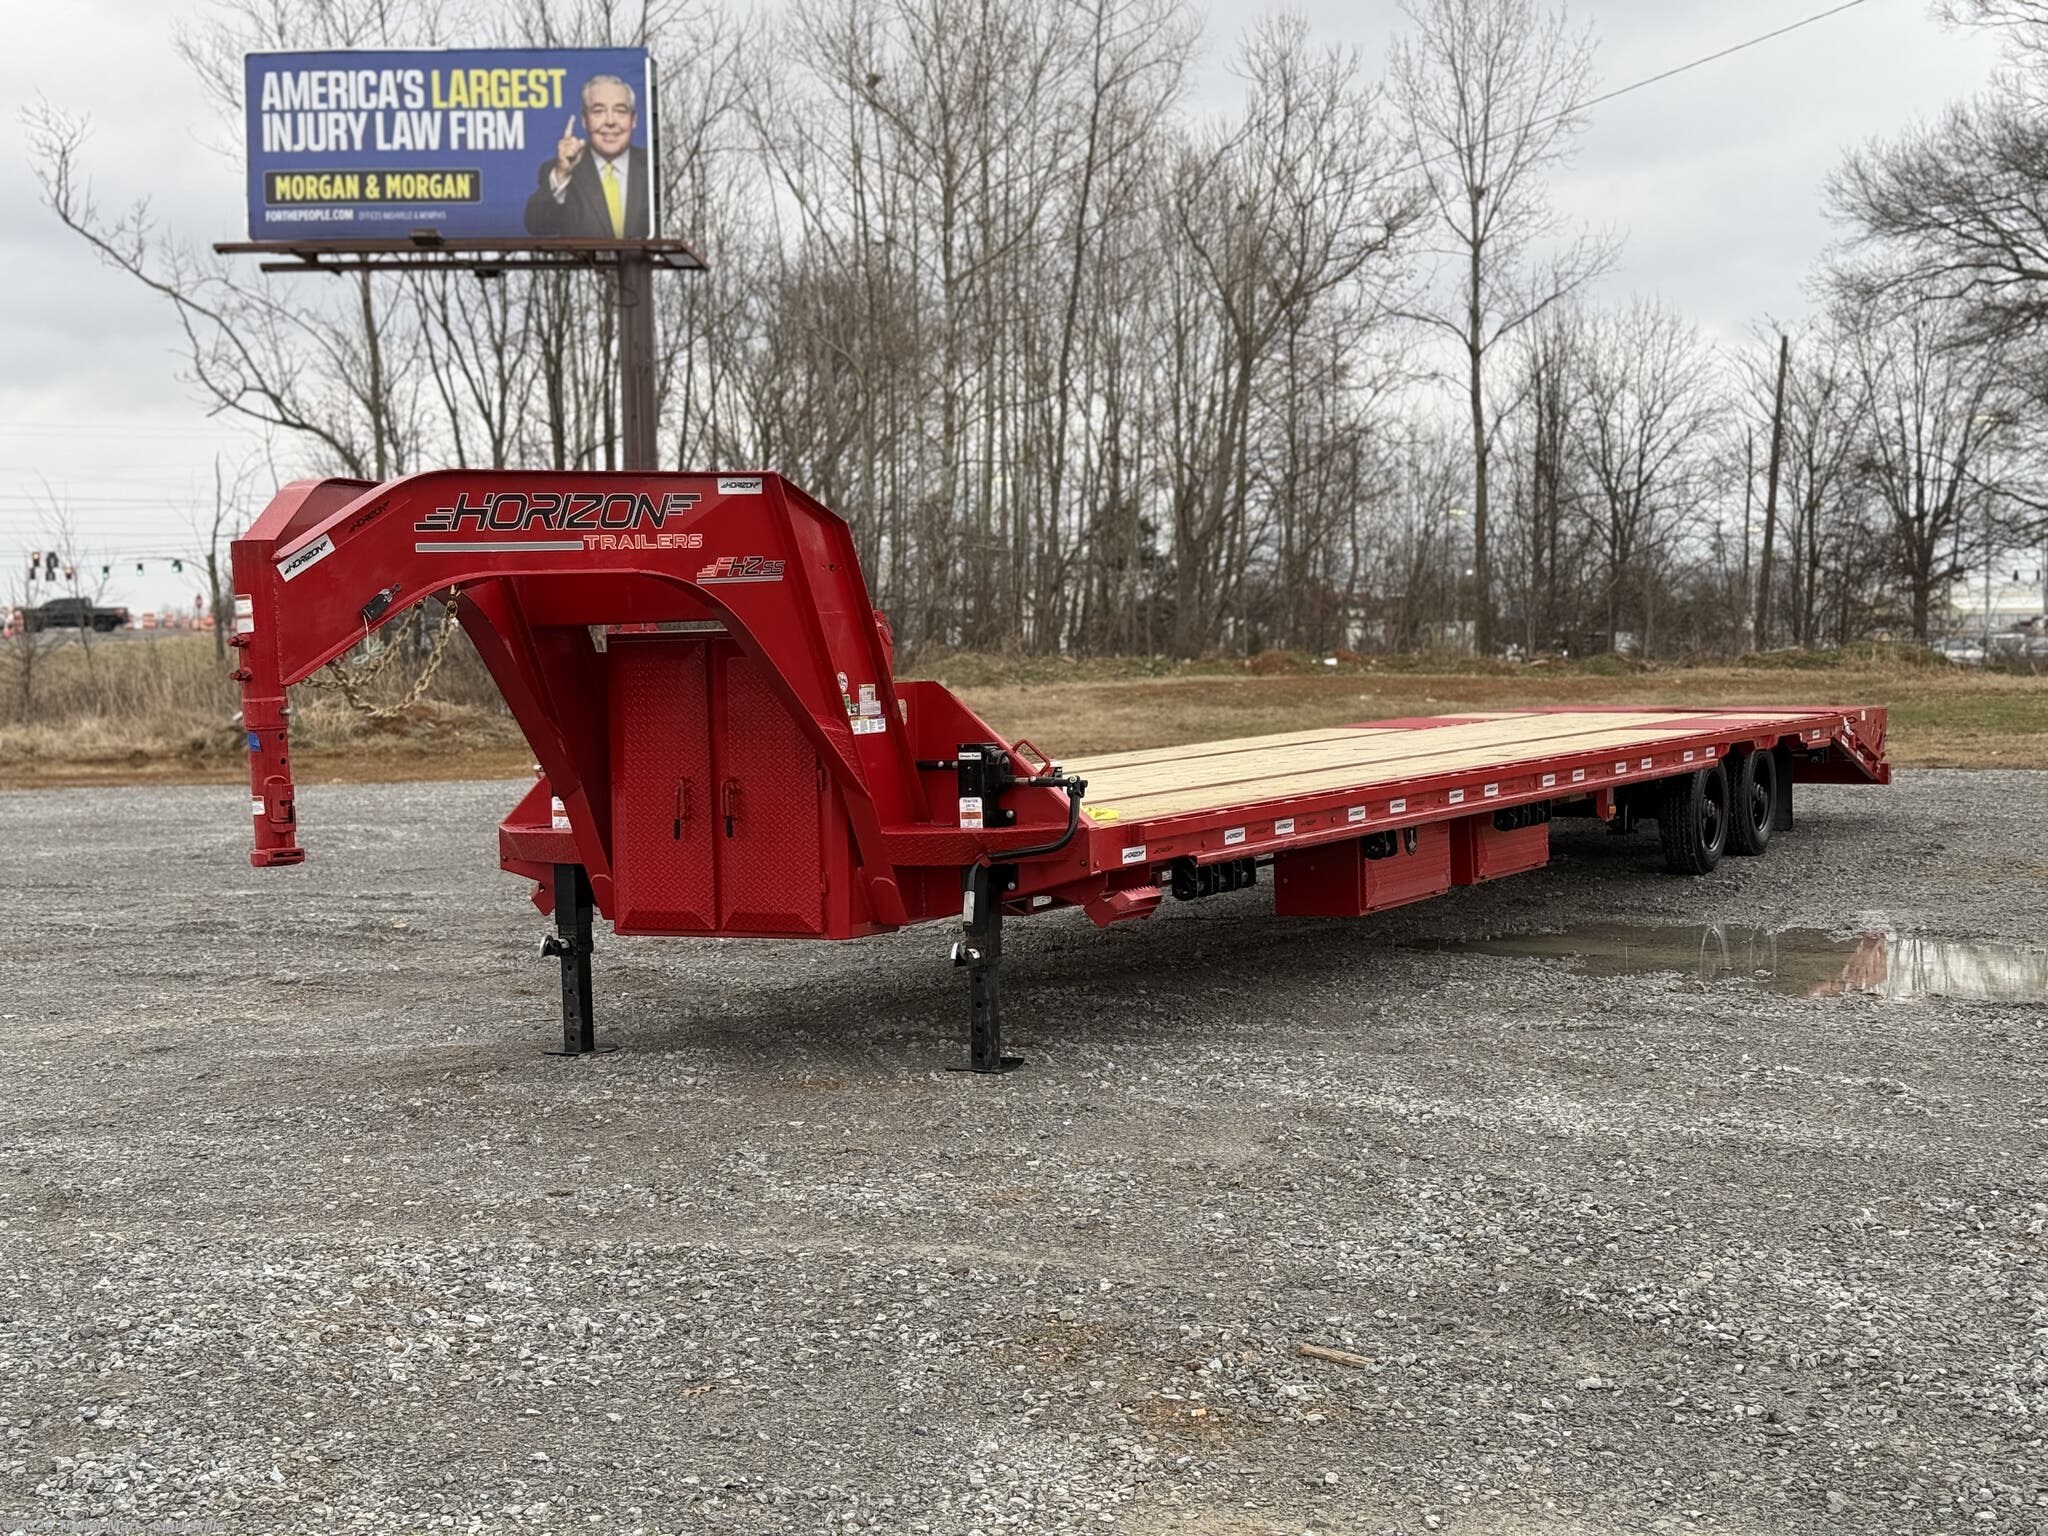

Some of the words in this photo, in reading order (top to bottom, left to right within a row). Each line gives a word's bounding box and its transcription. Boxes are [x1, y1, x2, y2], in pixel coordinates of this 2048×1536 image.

[261, 69, 425, 111] AMERICA'S
[431, 68, 567, 109] LARGEST
[262, 110, 368, 152] INJURY
[375, 110, 442, 151] LAW
[449, 110, 525, 150] FIRM
[275, 173, 360, 200] MORGAN
[365, 173, 380, 199] &
[385, 173, 471, 199] MORGAN
[265, 208, 354, 222] FORTHEPEOPLE.COM
[720, 481, 760, 489] HORIZON
[414, 493, 701, 532] HORIZON
[583, 533, 703, 550] TRAILERS
[284, 540, 328, 575] HORIZON
